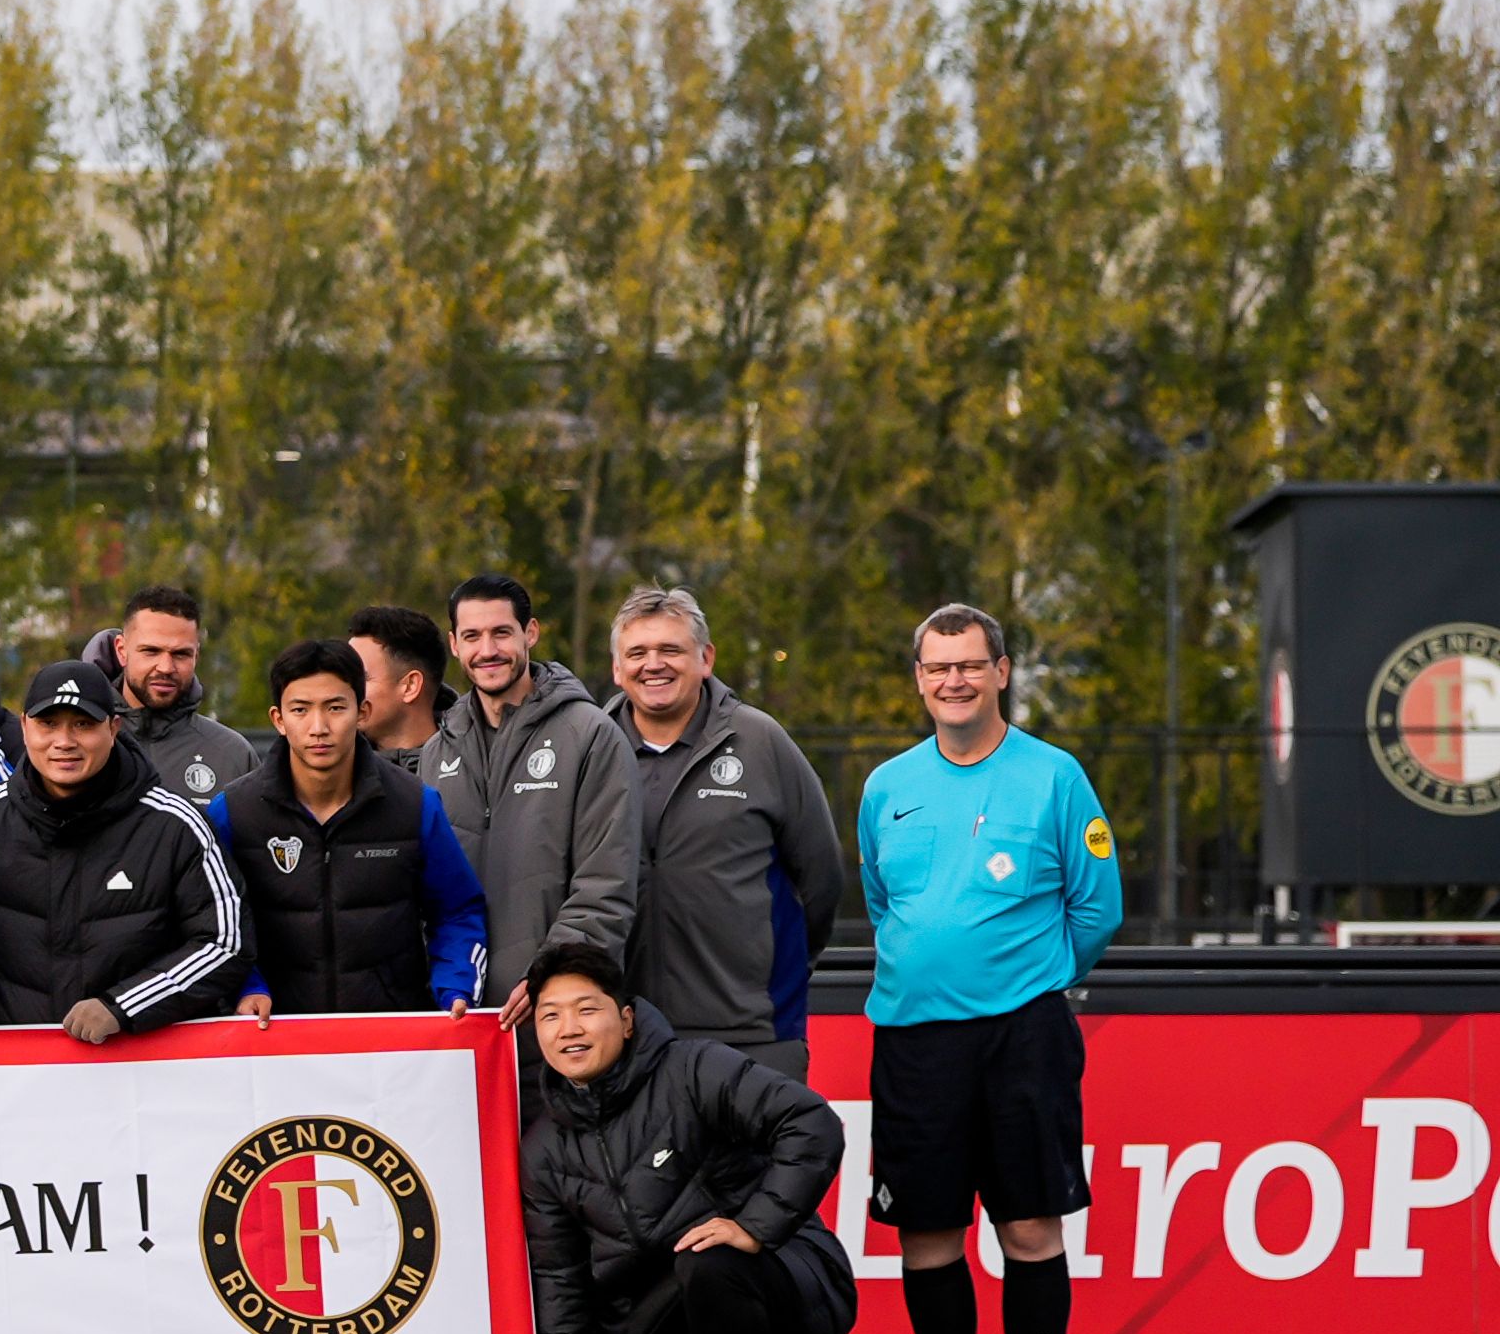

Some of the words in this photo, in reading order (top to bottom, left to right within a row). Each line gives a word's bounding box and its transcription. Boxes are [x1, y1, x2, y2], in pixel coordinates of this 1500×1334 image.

[1383, 633, 1500, 696] FEYENO
[1386, 743, 1500, 808] ROTTER
[215, 1123, 417, 1205] FEYENOORD
[136, 1173, 156, 1254] !
[269, 1178, 360, 1292] F
